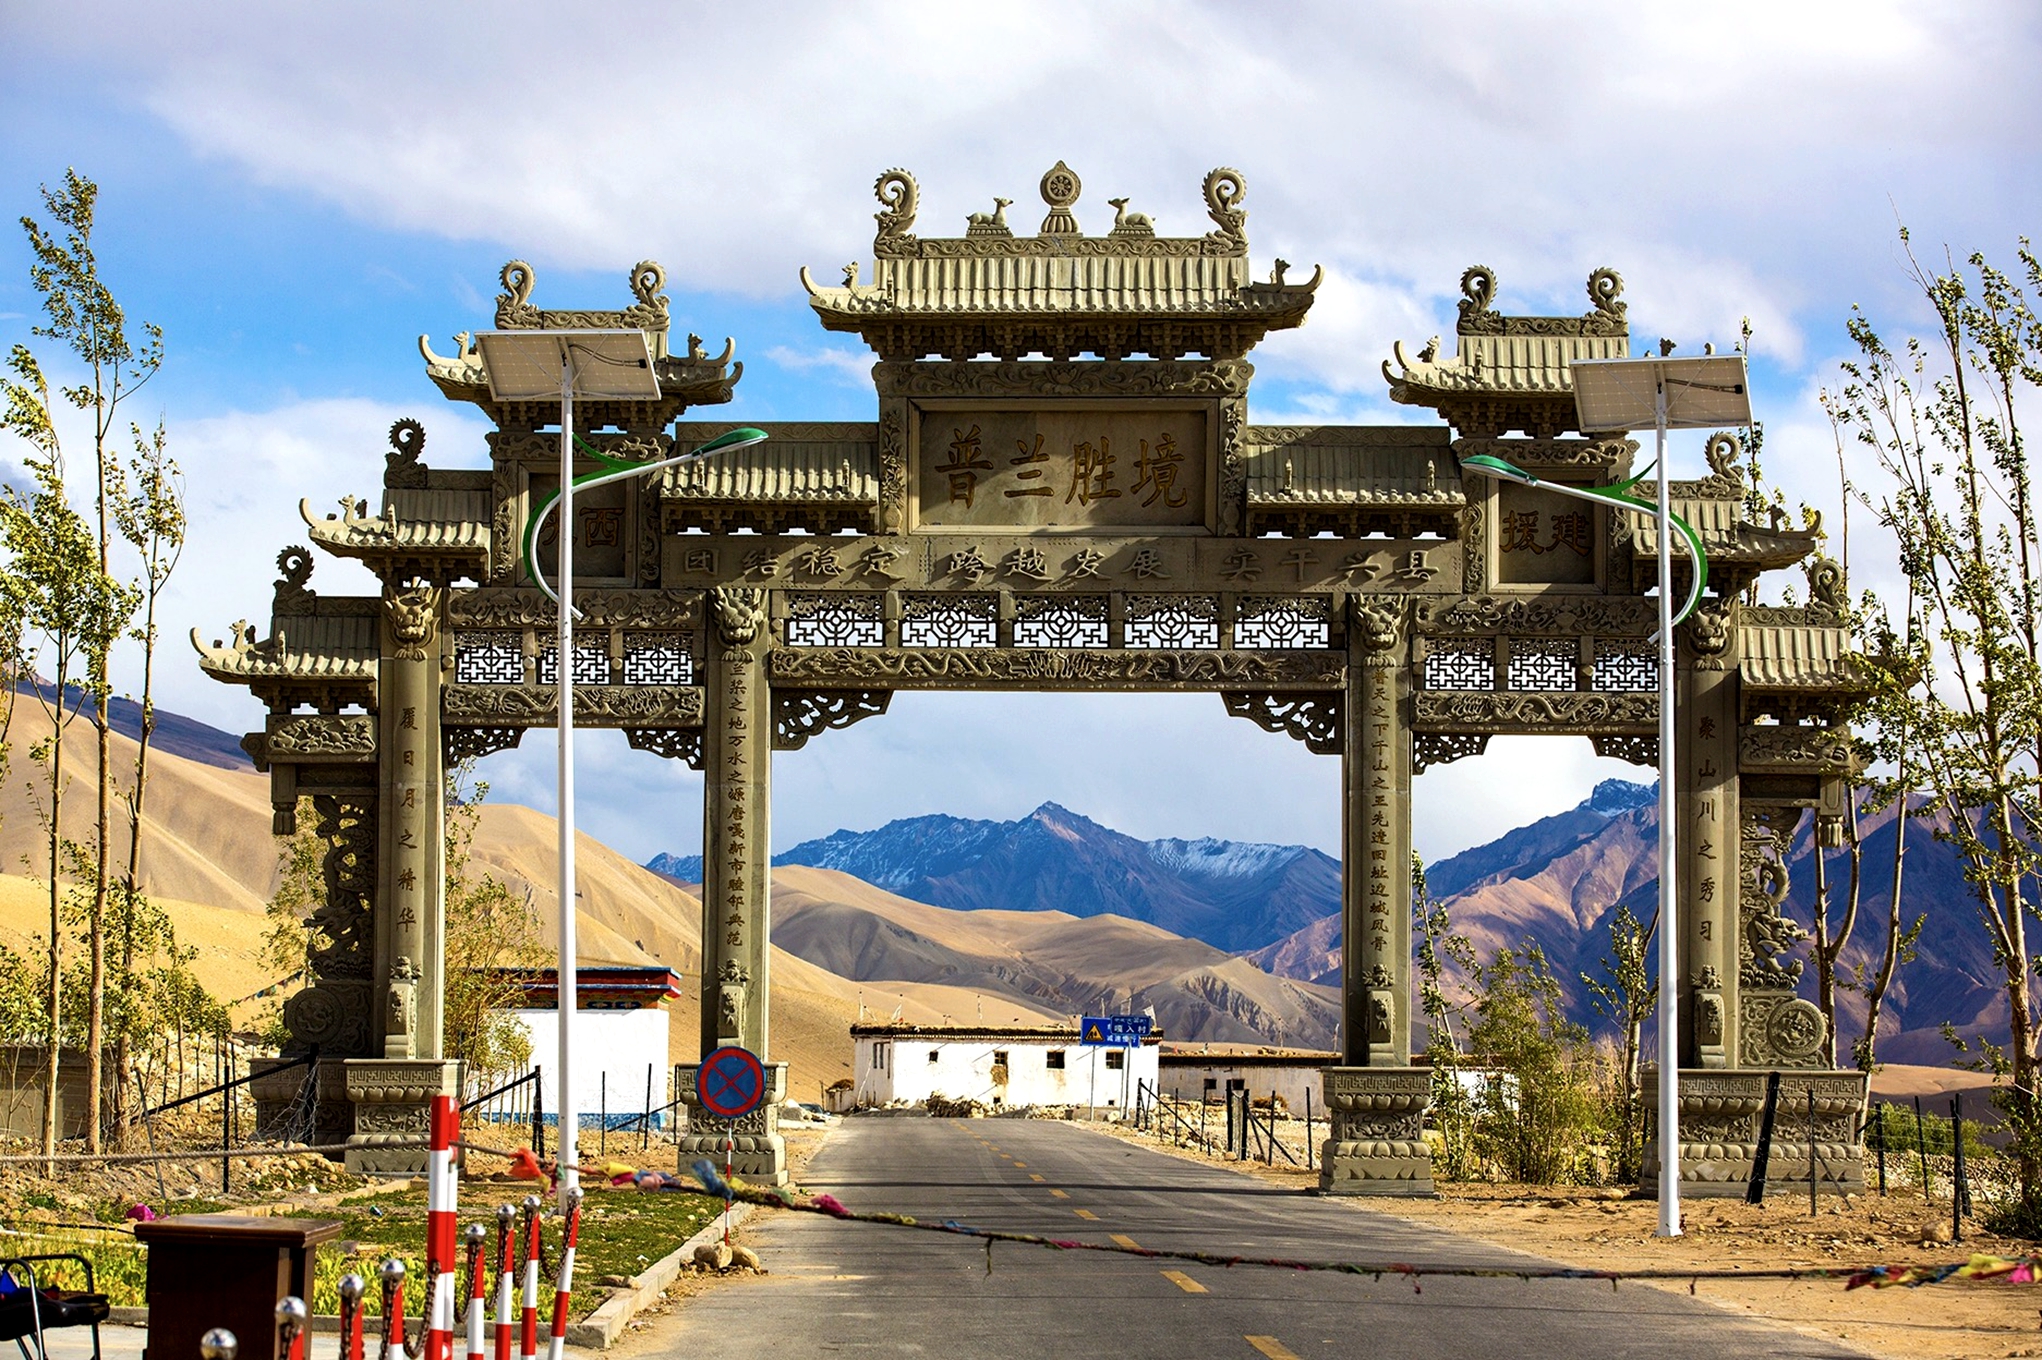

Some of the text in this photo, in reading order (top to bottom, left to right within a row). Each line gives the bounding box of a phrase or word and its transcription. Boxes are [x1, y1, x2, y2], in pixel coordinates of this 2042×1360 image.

[935, 424, 1188, 509] 普兰胜境
[1499, 510, 1593, 557] 援建
[683, 544, 1439, 583] 团结稳定 跨越发展 实干兴县
